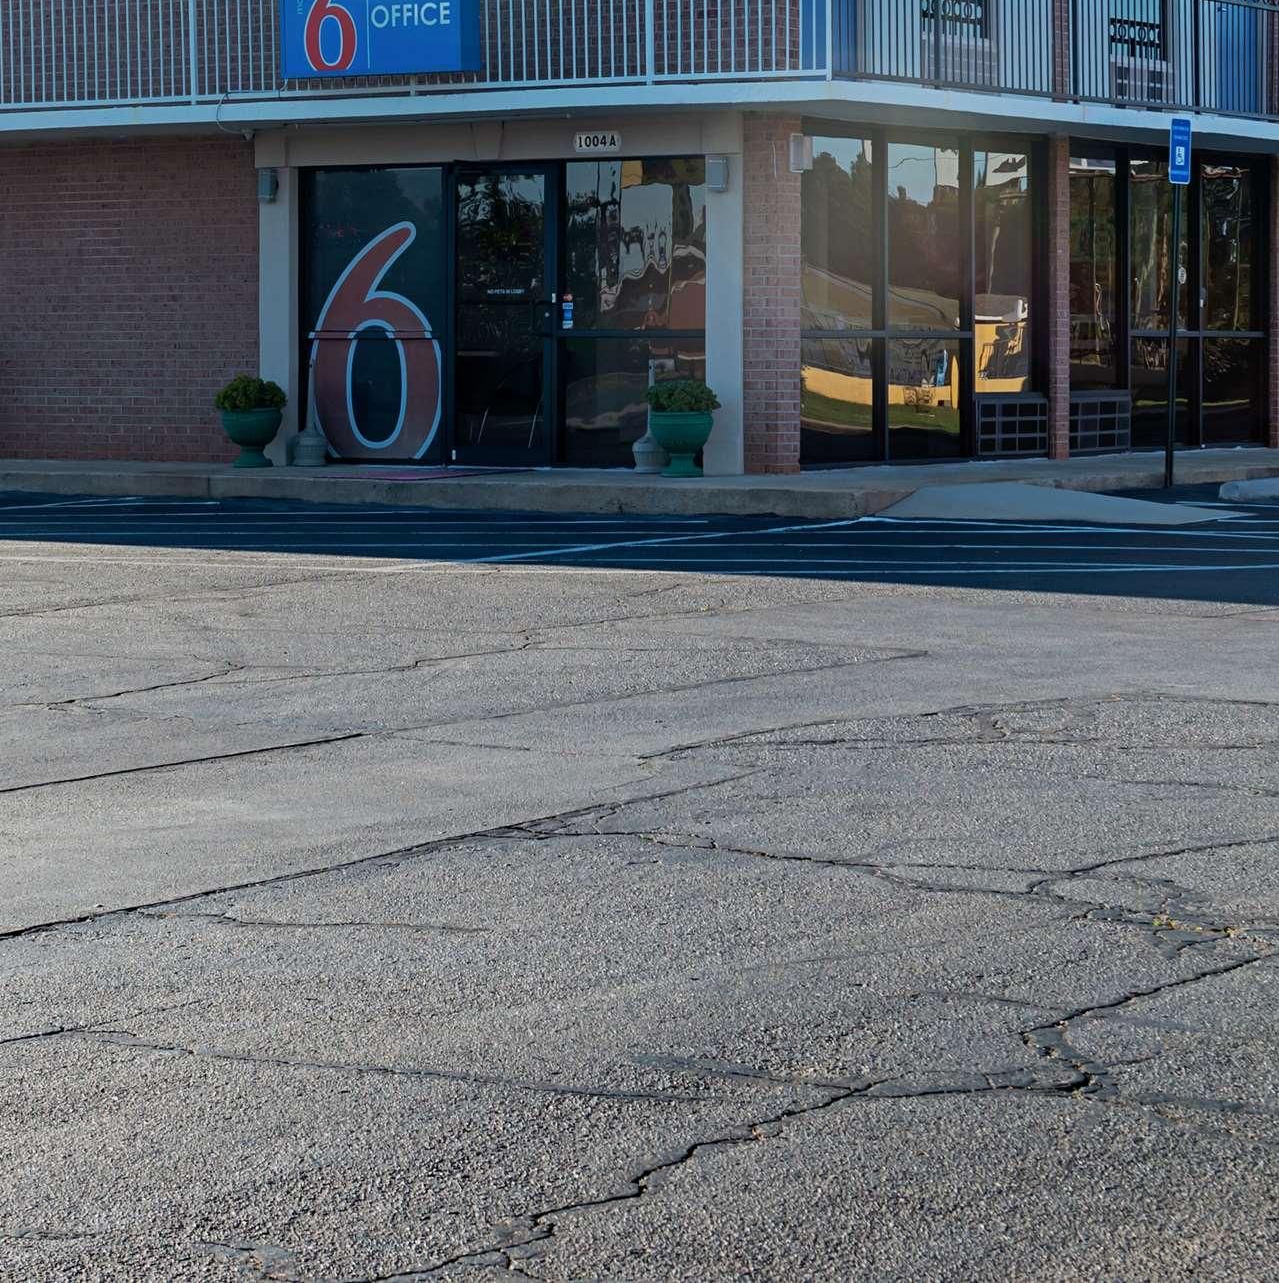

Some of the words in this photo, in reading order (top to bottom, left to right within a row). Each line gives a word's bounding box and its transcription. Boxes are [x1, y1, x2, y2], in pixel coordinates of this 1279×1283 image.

[371, 2, 450, 28] OFFICE
[578, 134, 616, 148] 1004A
[308, 221, 442, 459] 6
